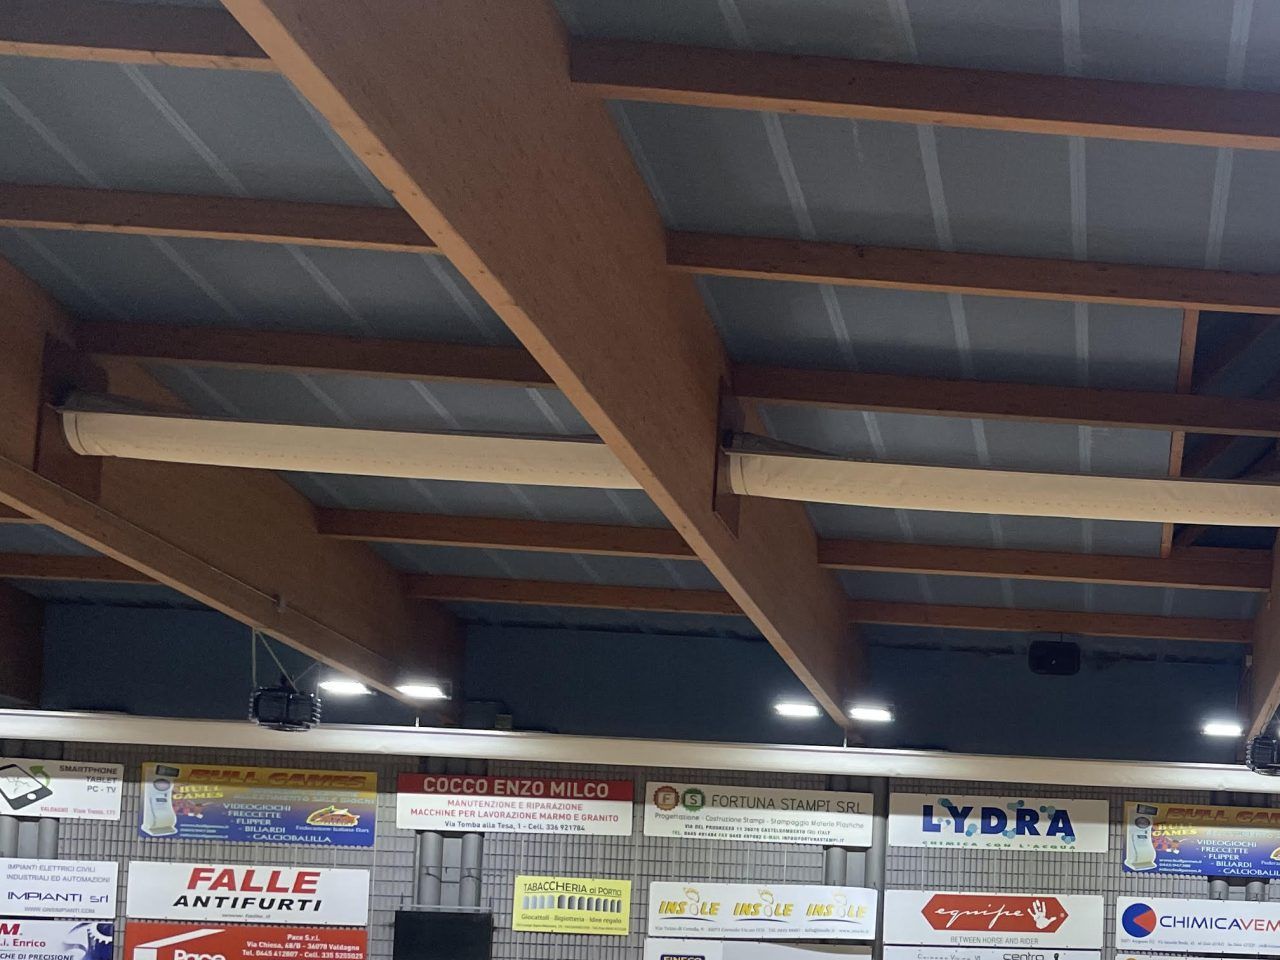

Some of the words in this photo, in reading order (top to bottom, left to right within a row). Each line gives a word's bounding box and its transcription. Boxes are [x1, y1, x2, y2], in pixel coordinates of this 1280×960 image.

[59, 765, 118, 774] SMARTPHONE
[269, 772, 366, 788] GAMES
[423, 777, 489, 792] COCCO
[494, 780, 544, 796] ENZO
[551, 782, 609, 798] MILCO
[712, 795, 777, 809] FORTUNA
[781, 799, 831, 812] STAMPI
[837, 801, 862, 813] SRL
[411, 809, 456, 818] MACCHINE
[478, 811, 537, 820] LAVORAZIONE
[540, 813, 570, 821] MARMO
[582, 814, 619, 822] GRANITO
[922, 805, 1075, 837] LYDRA
[1166, 807, 1229, 822] BULL
[187, 868, 321, 894] FALLE
[524, 881, 587, 892] TABACCHERIA
[8, 892, 81, 902] IMPIANTI
[90, 895, 108, 903] srl
[173, 896, 322, 911] ANTIFURTI
[935, 904, 1024, 929] equipe
[13, 939, 46, 947] Enrico
[1003, 952, 1044, 960] centro
